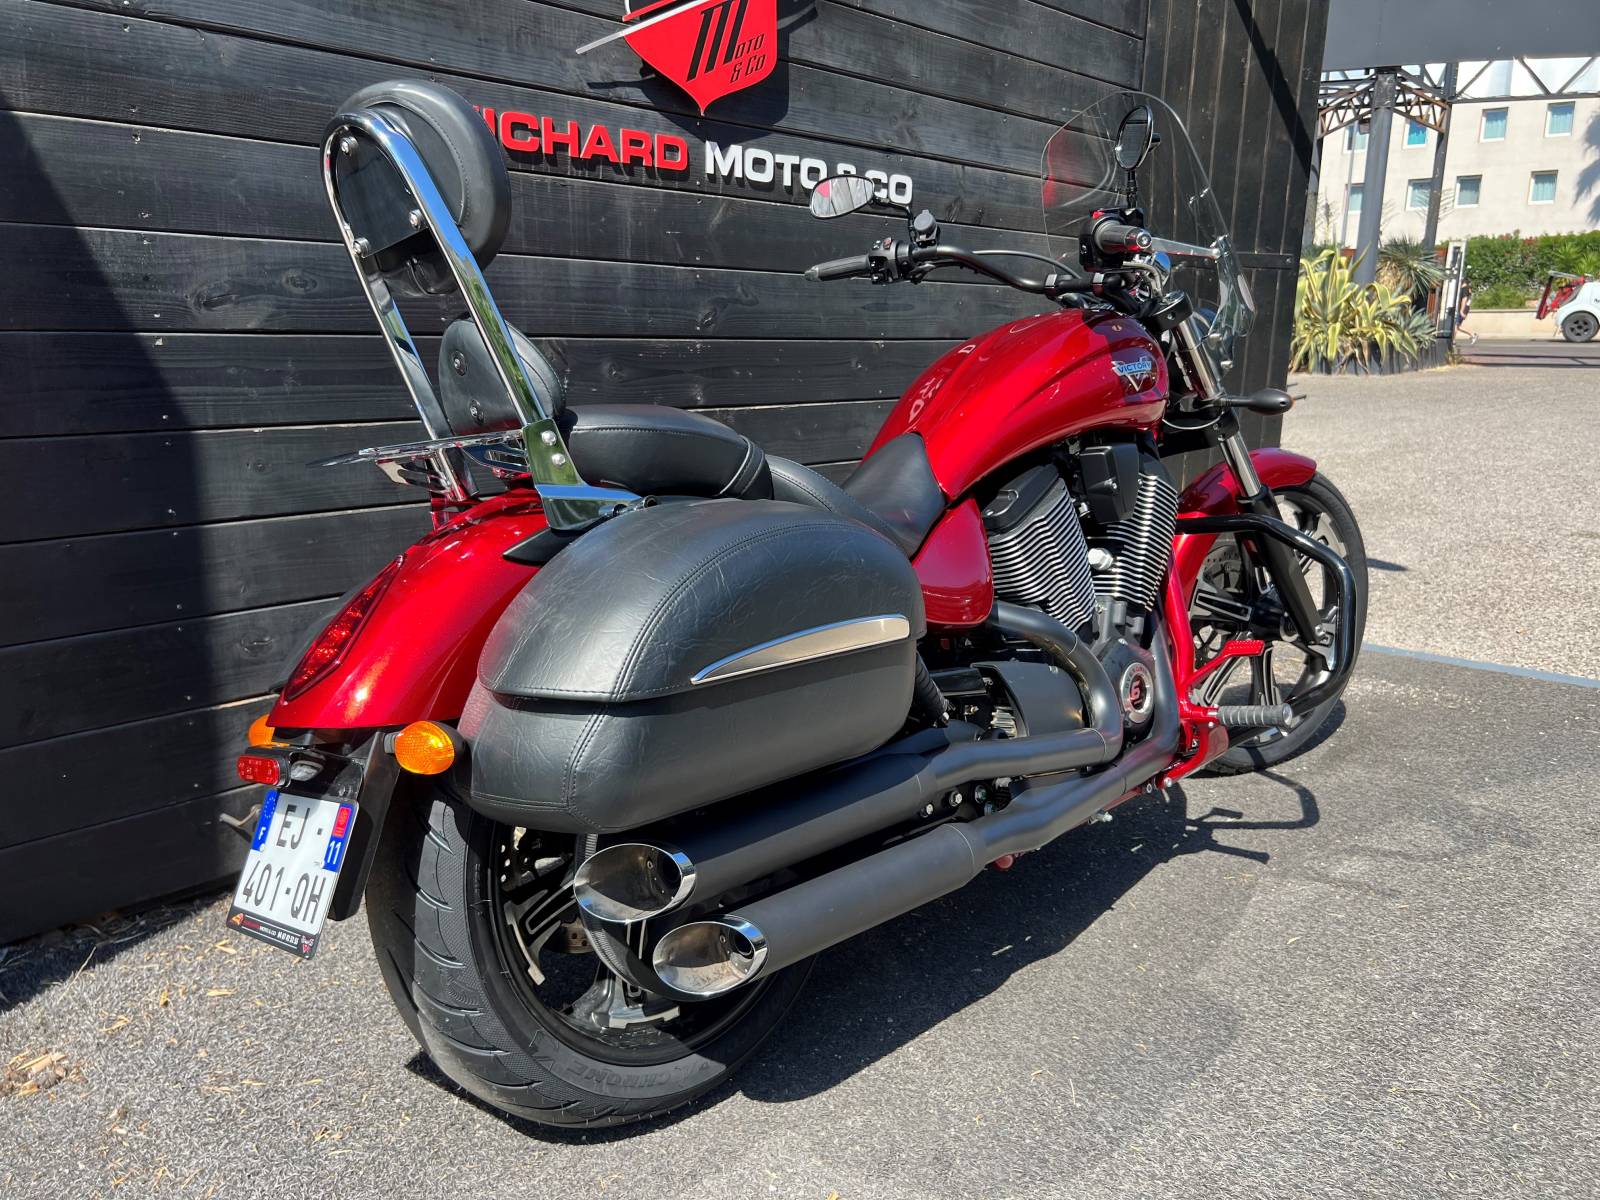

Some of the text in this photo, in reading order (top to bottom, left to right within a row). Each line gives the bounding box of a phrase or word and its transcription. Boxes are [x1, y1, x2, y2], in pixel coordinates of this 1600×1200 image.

[730, 62, 742, 83] &
[473, 105, 688, 171] CHARD
[705, 140, 828, 190] MOTO
[1117, 361, 1151, 373] VICTORY
[258, 826, 267, 841] F
[327, 840, 342, 865] 11
[242, 860, 327, 924] 401-QH
